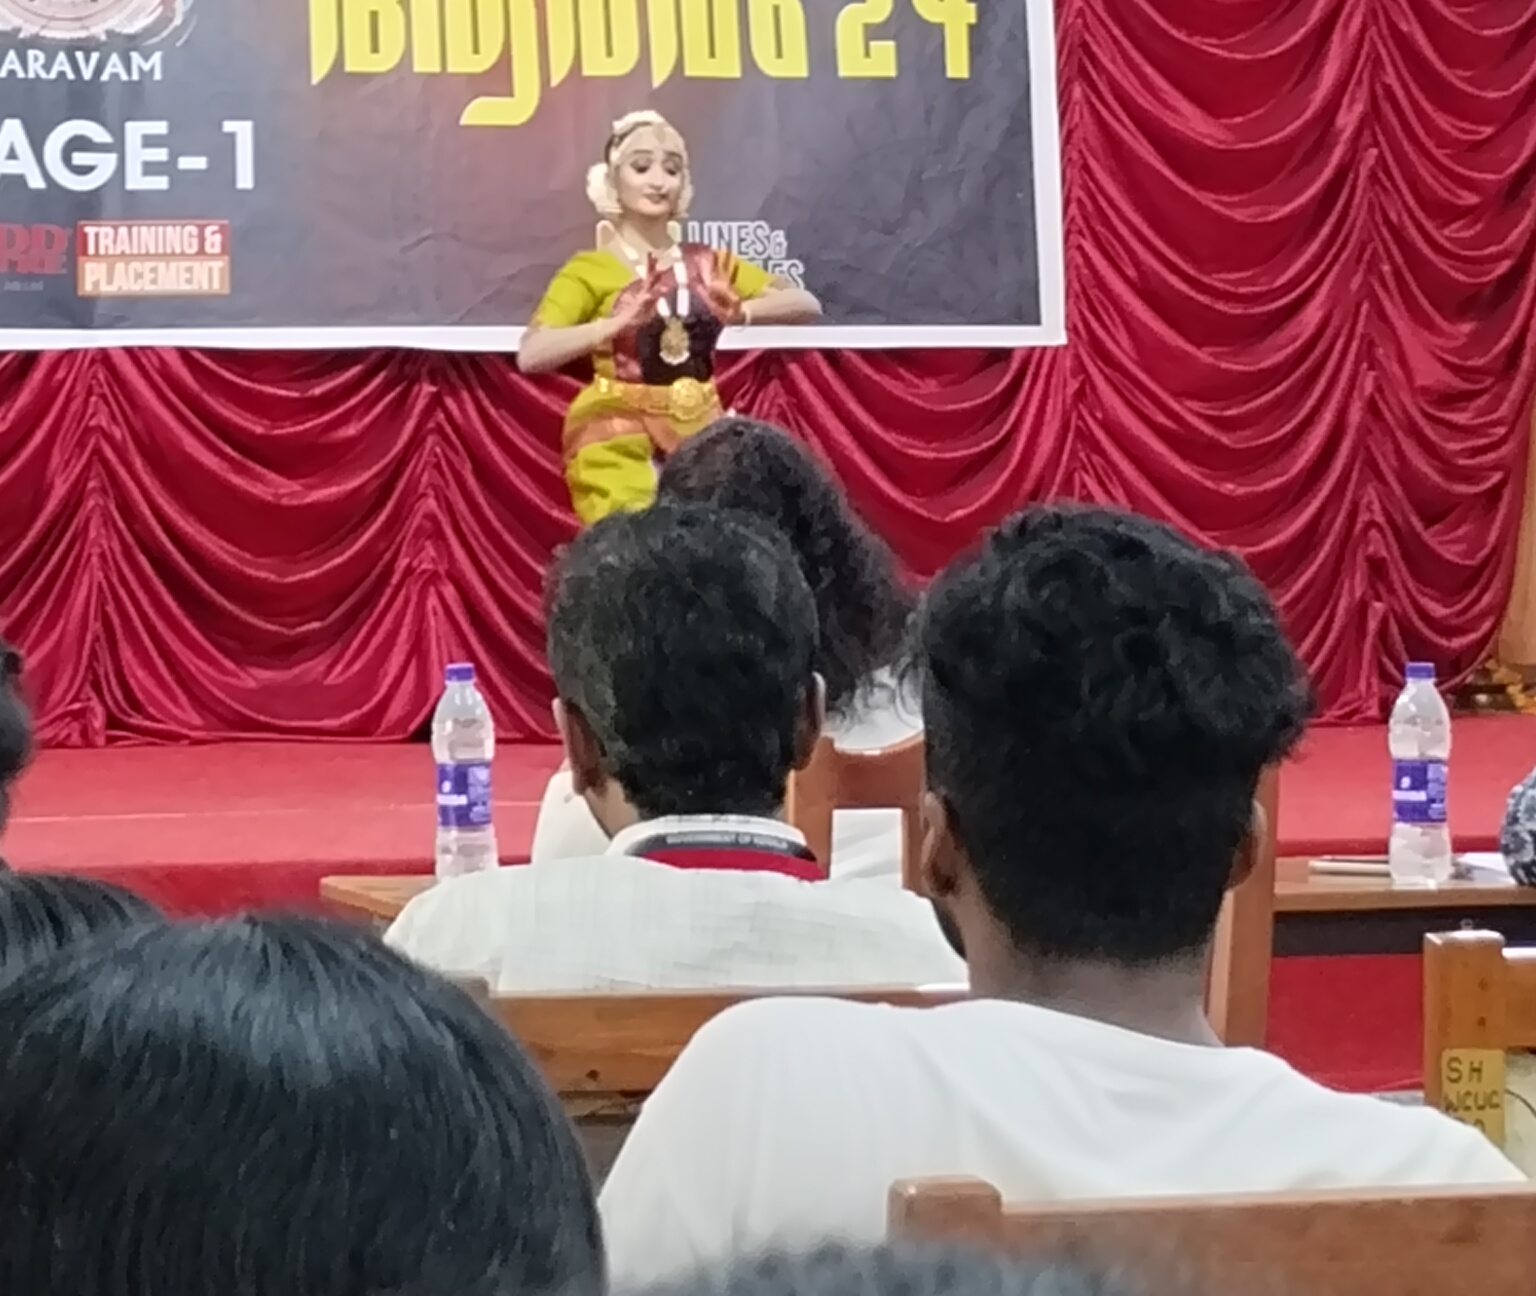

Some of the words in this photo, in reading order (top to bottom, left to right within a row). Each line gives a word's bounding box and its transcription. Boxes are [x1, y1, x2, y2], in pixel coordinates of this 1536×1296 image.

[84, 225, 199, 255] TRAINING
[204, 224, 222, 254] &
[84, 261, 224, 292] PLACEMENT
